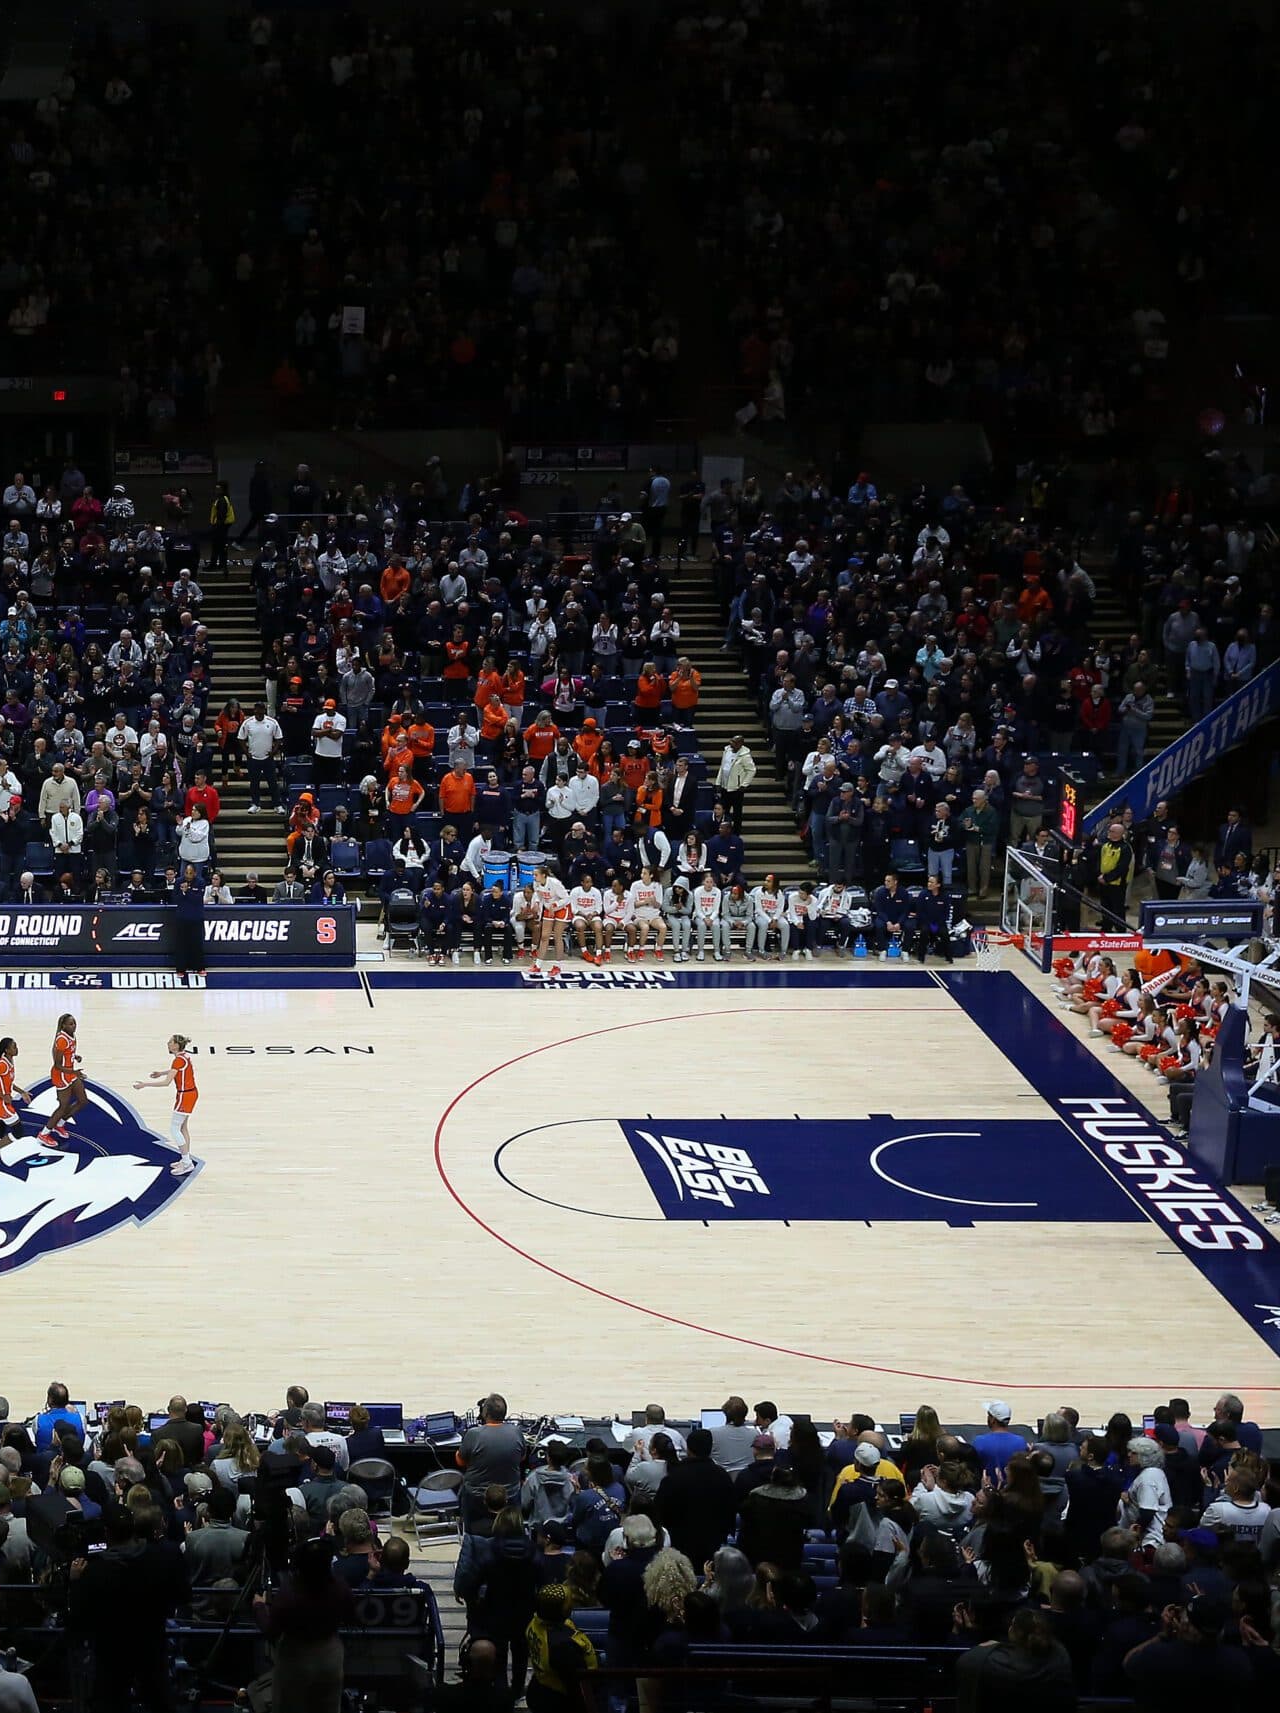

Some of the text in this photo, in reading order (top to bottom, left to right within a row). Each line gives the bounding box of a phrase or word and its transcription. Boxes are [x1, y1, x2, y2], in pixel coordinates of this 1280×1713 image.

[1146, 678, 1271, 808] FOUR IT ALL
[15, 914, 82, 936] ROUND
[115, 923, 164, 938] ACC
[204, 920, 291, 941] YRACUSE
[316, 916, 337, 944] S
[0, 936, 9, 946] OF
[10, 936, 60, 946] CONNECTICUT
[111, 973, 207, 989] WORLD
[520, 971, 676, 982] UCONN
[544, 982, 662, 990] HEALTH
[660, 1135, 736, 1208] EAST
[702, 1142, 771, 1196] BIG
[1057, 1097, 1265, 1251] HUSKIES
